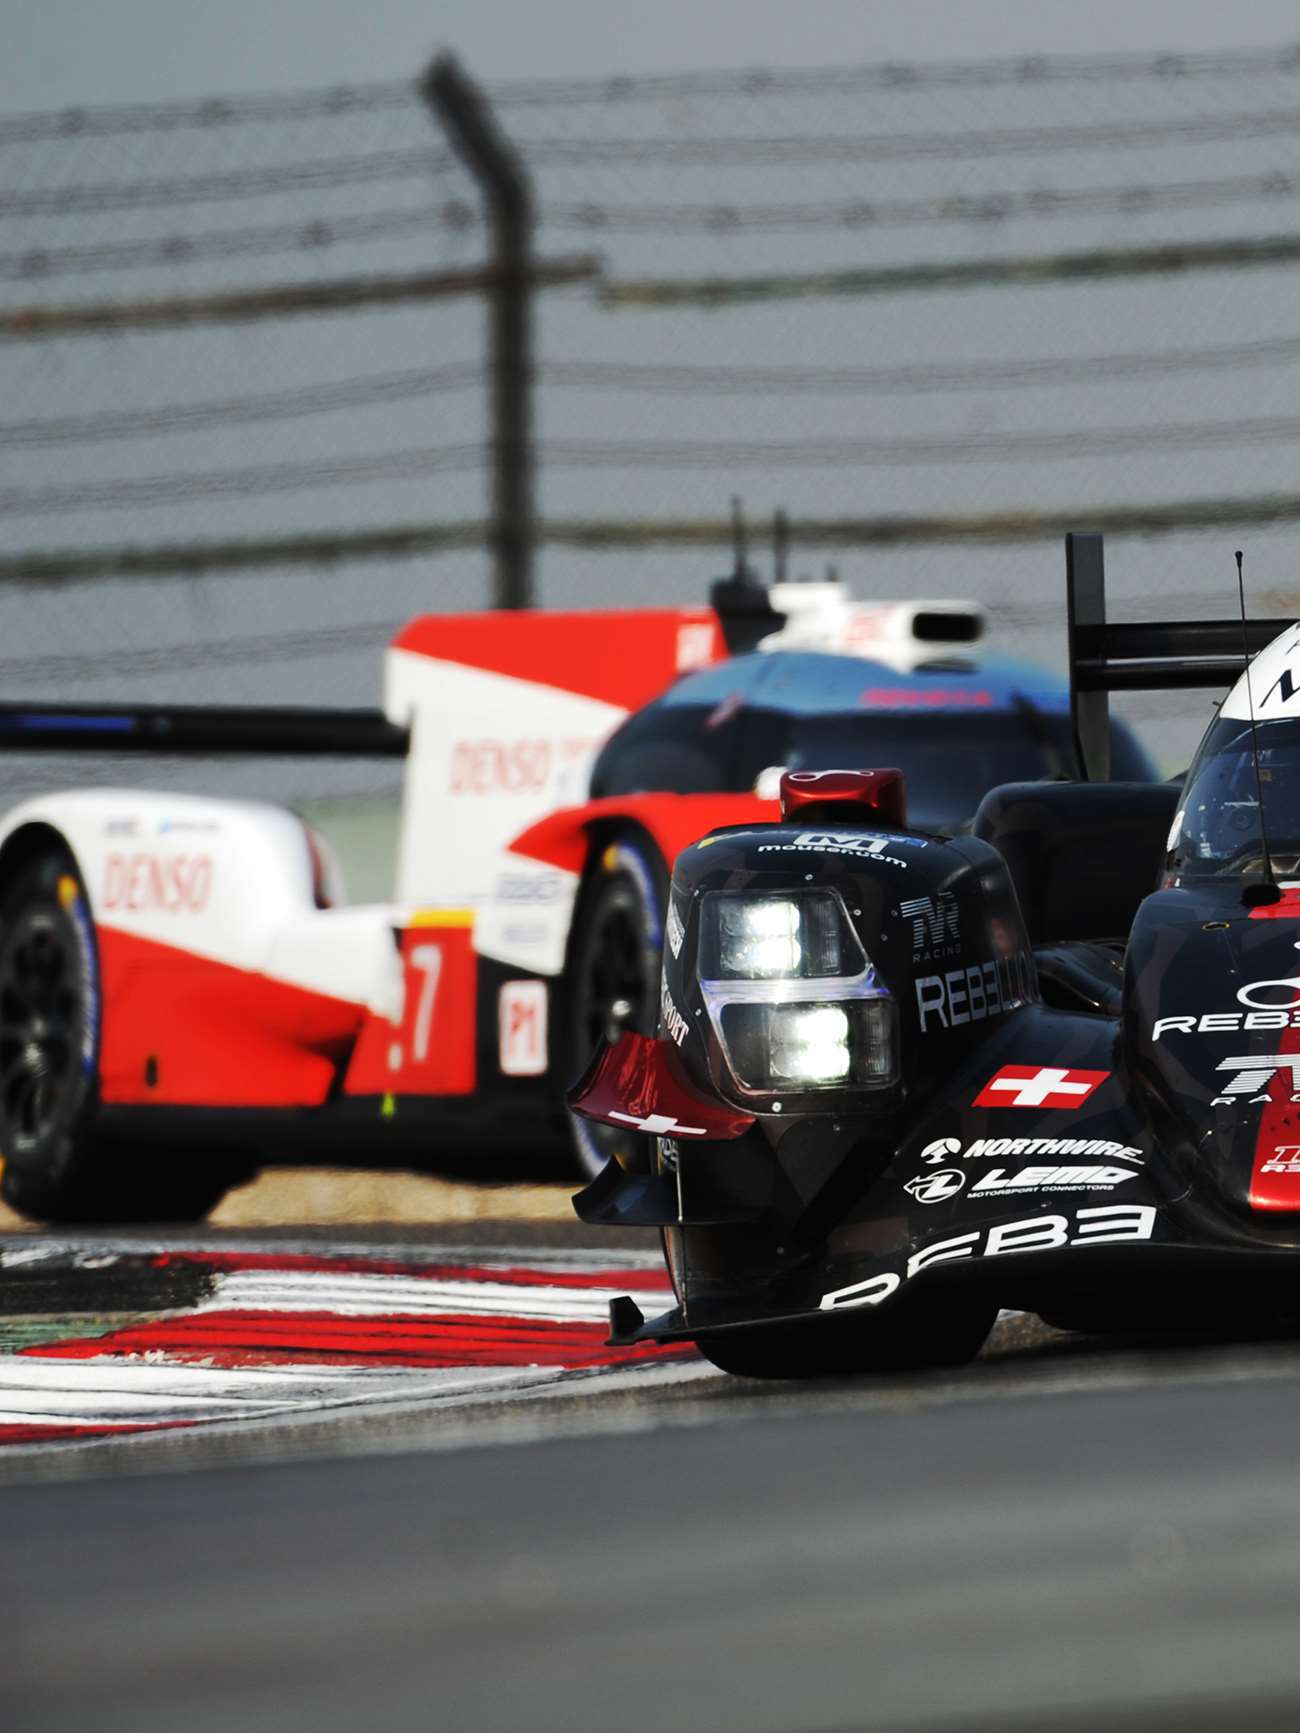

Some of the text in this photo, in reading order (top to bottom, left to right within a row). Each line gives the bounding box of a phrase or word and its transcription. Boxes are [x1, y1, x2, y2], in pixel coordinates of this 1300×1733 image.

[758, 844, 908, 868] mouser.com
[104, 853, 212, 914] DENSO
[411, 944, 443, 1063] 7
[963, 1138, 1143, 1161] NORTHWIRE
[971, 1166, 1140, 1191] LEMO
[967, 1184, 1115, 1199] MOTORSPORT CONNECTORS
